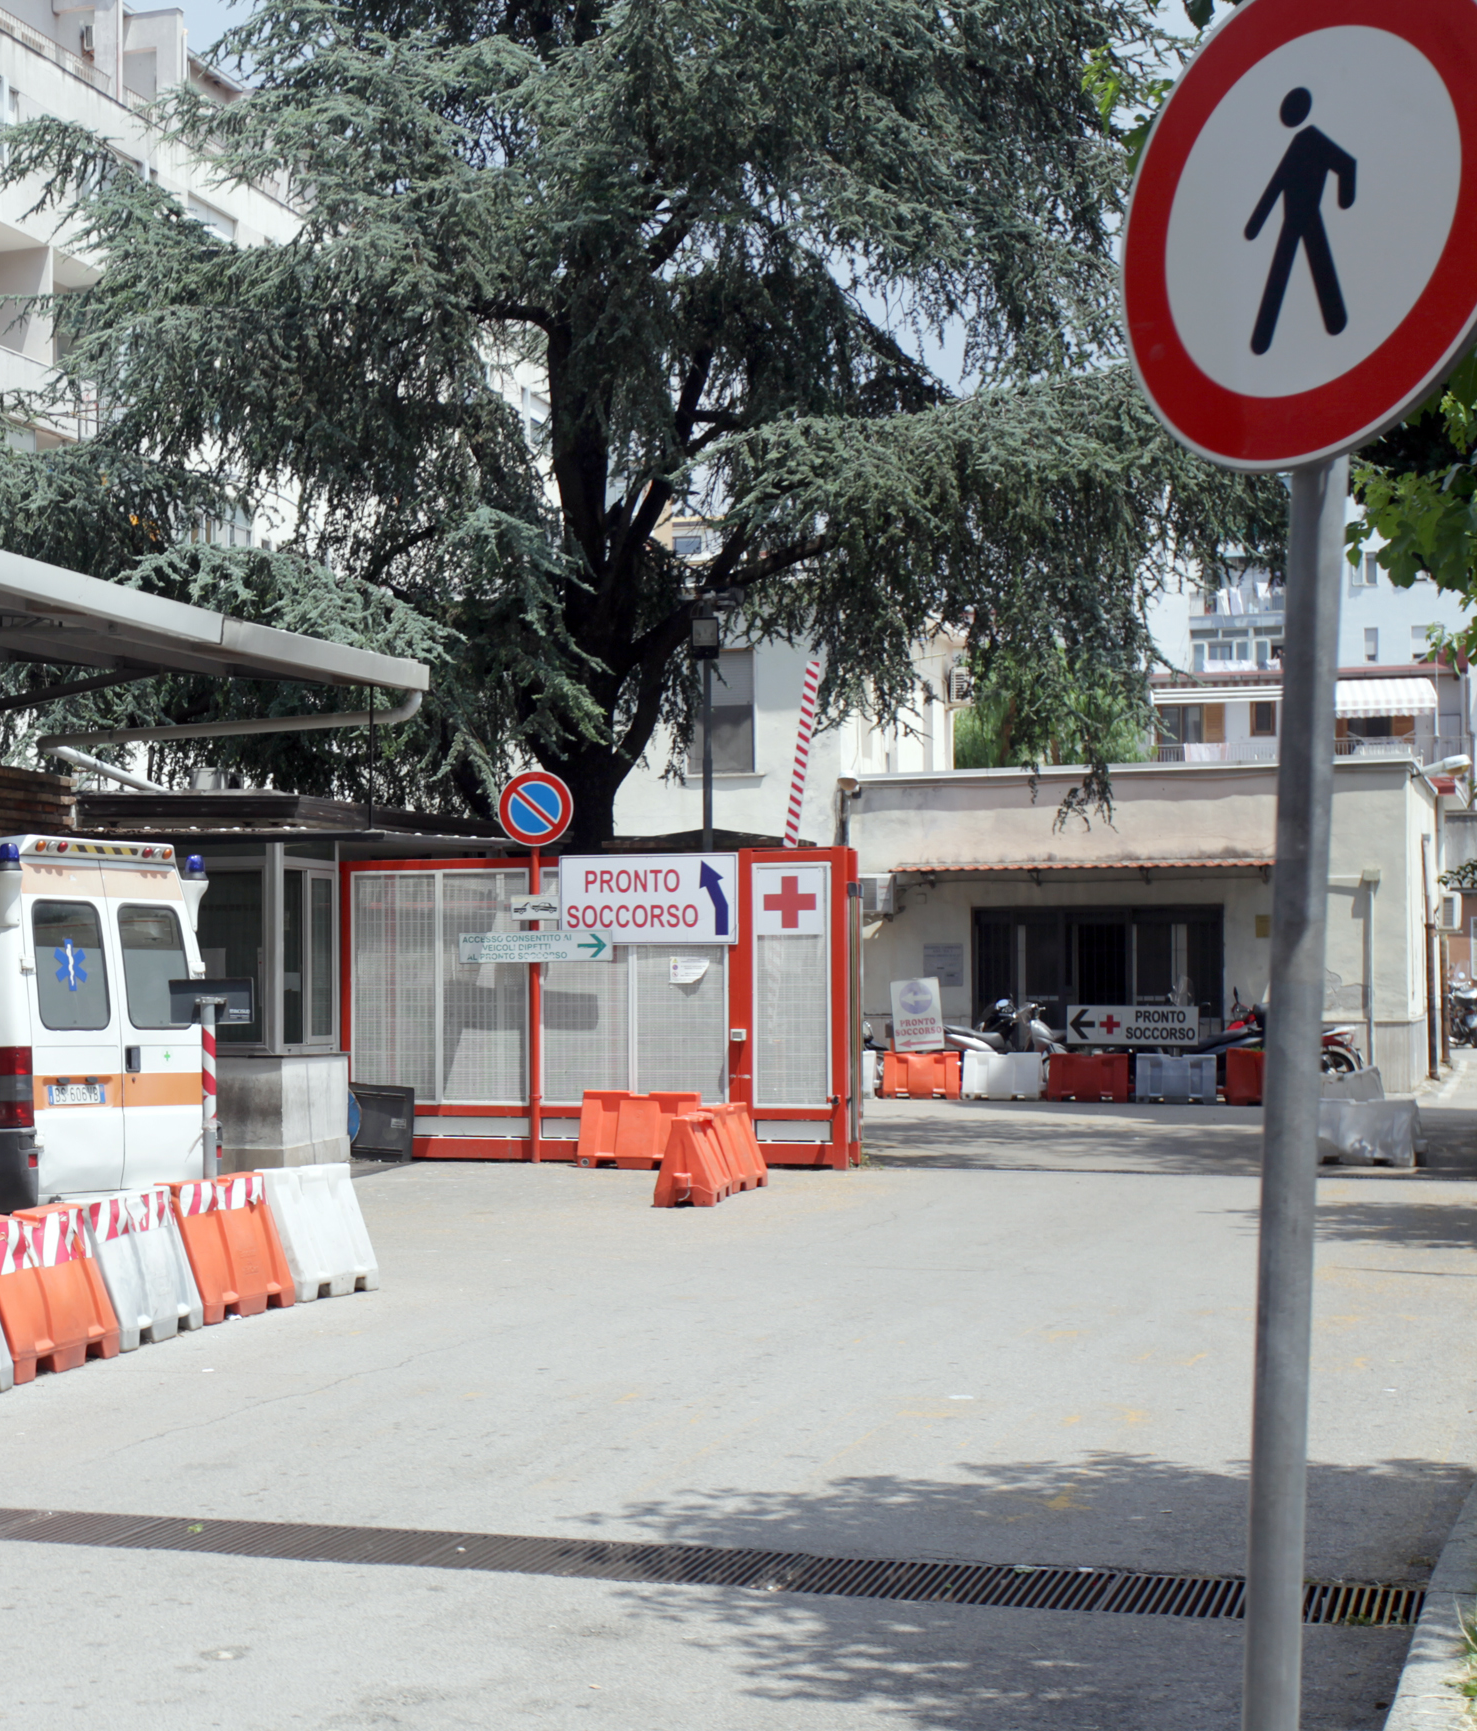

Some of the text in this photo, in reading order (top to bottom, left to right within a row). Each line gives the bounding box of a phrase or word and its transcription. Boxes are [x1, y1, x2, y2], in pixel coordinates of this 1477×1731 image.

[584, 868, 680, 894] PRONTO
[567, 904, 699, 929] SOCCORSO
[462, 935, 503, 943] ACCESSO
[505, 934, 561, 942] CONSENTITO
[482, 944, 516, 952] VEICOLI
[900, 1017, 936, 1027] PRONTO
[1135, 1010, 1186, 1023] PRONTO
[895, 1026, 942, 1036] SOCCORSO
[1126, 1027, 1195, 1040] SOCCORSO
[55, 1086, 98, 1102] BS 606VB
